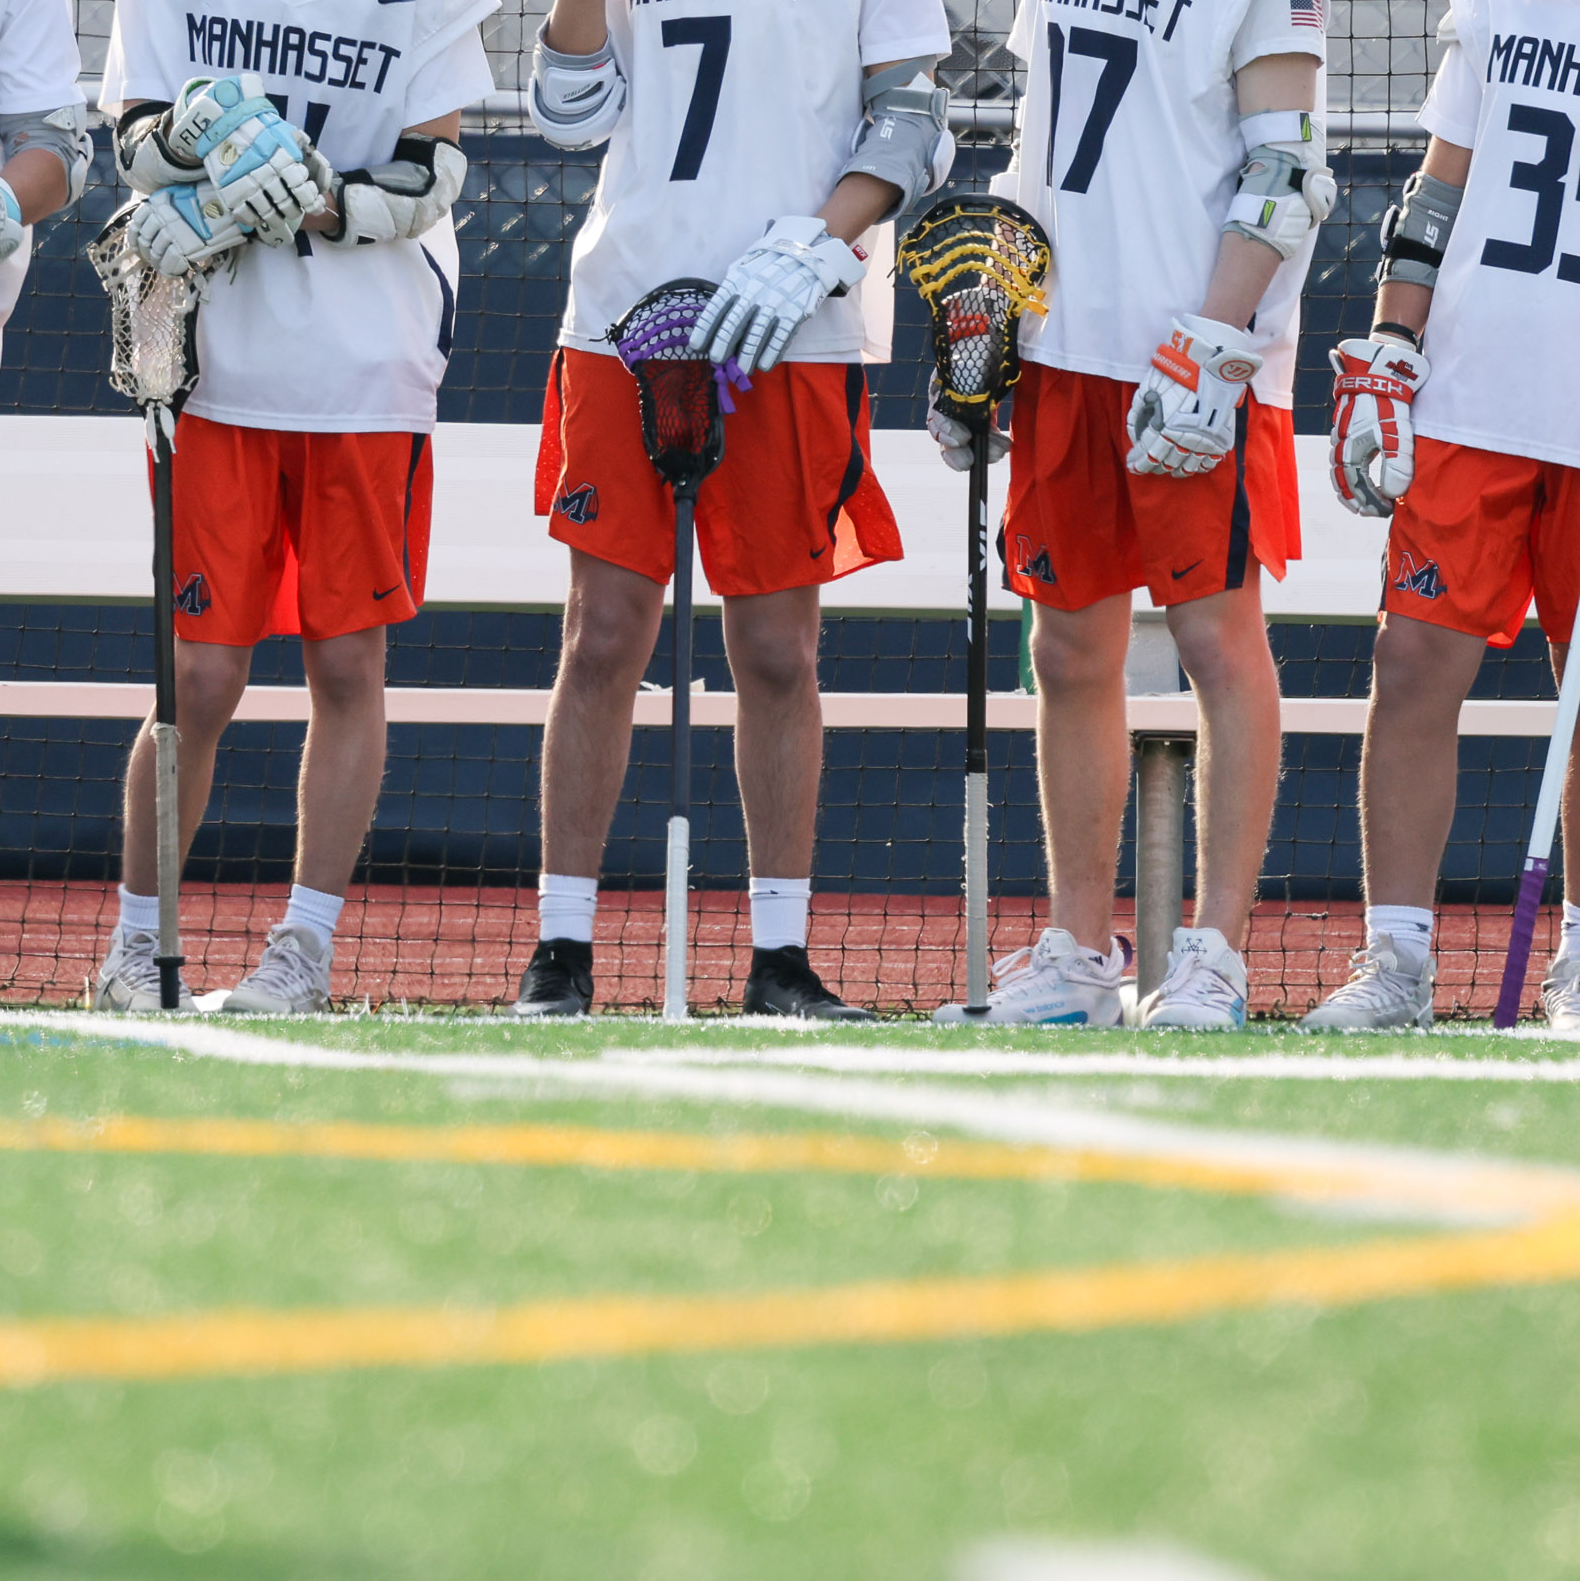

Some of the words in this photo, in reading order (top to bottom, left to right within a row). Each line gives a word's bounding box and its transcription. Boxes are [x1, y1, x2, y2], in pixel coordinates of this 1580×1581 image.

[186, 12, 402, 94] MANHASSET
[661, 15, 732, 182] 7
[1047, 21, 1138, 195] 17
[1423, 220, 1440, 249] ST
